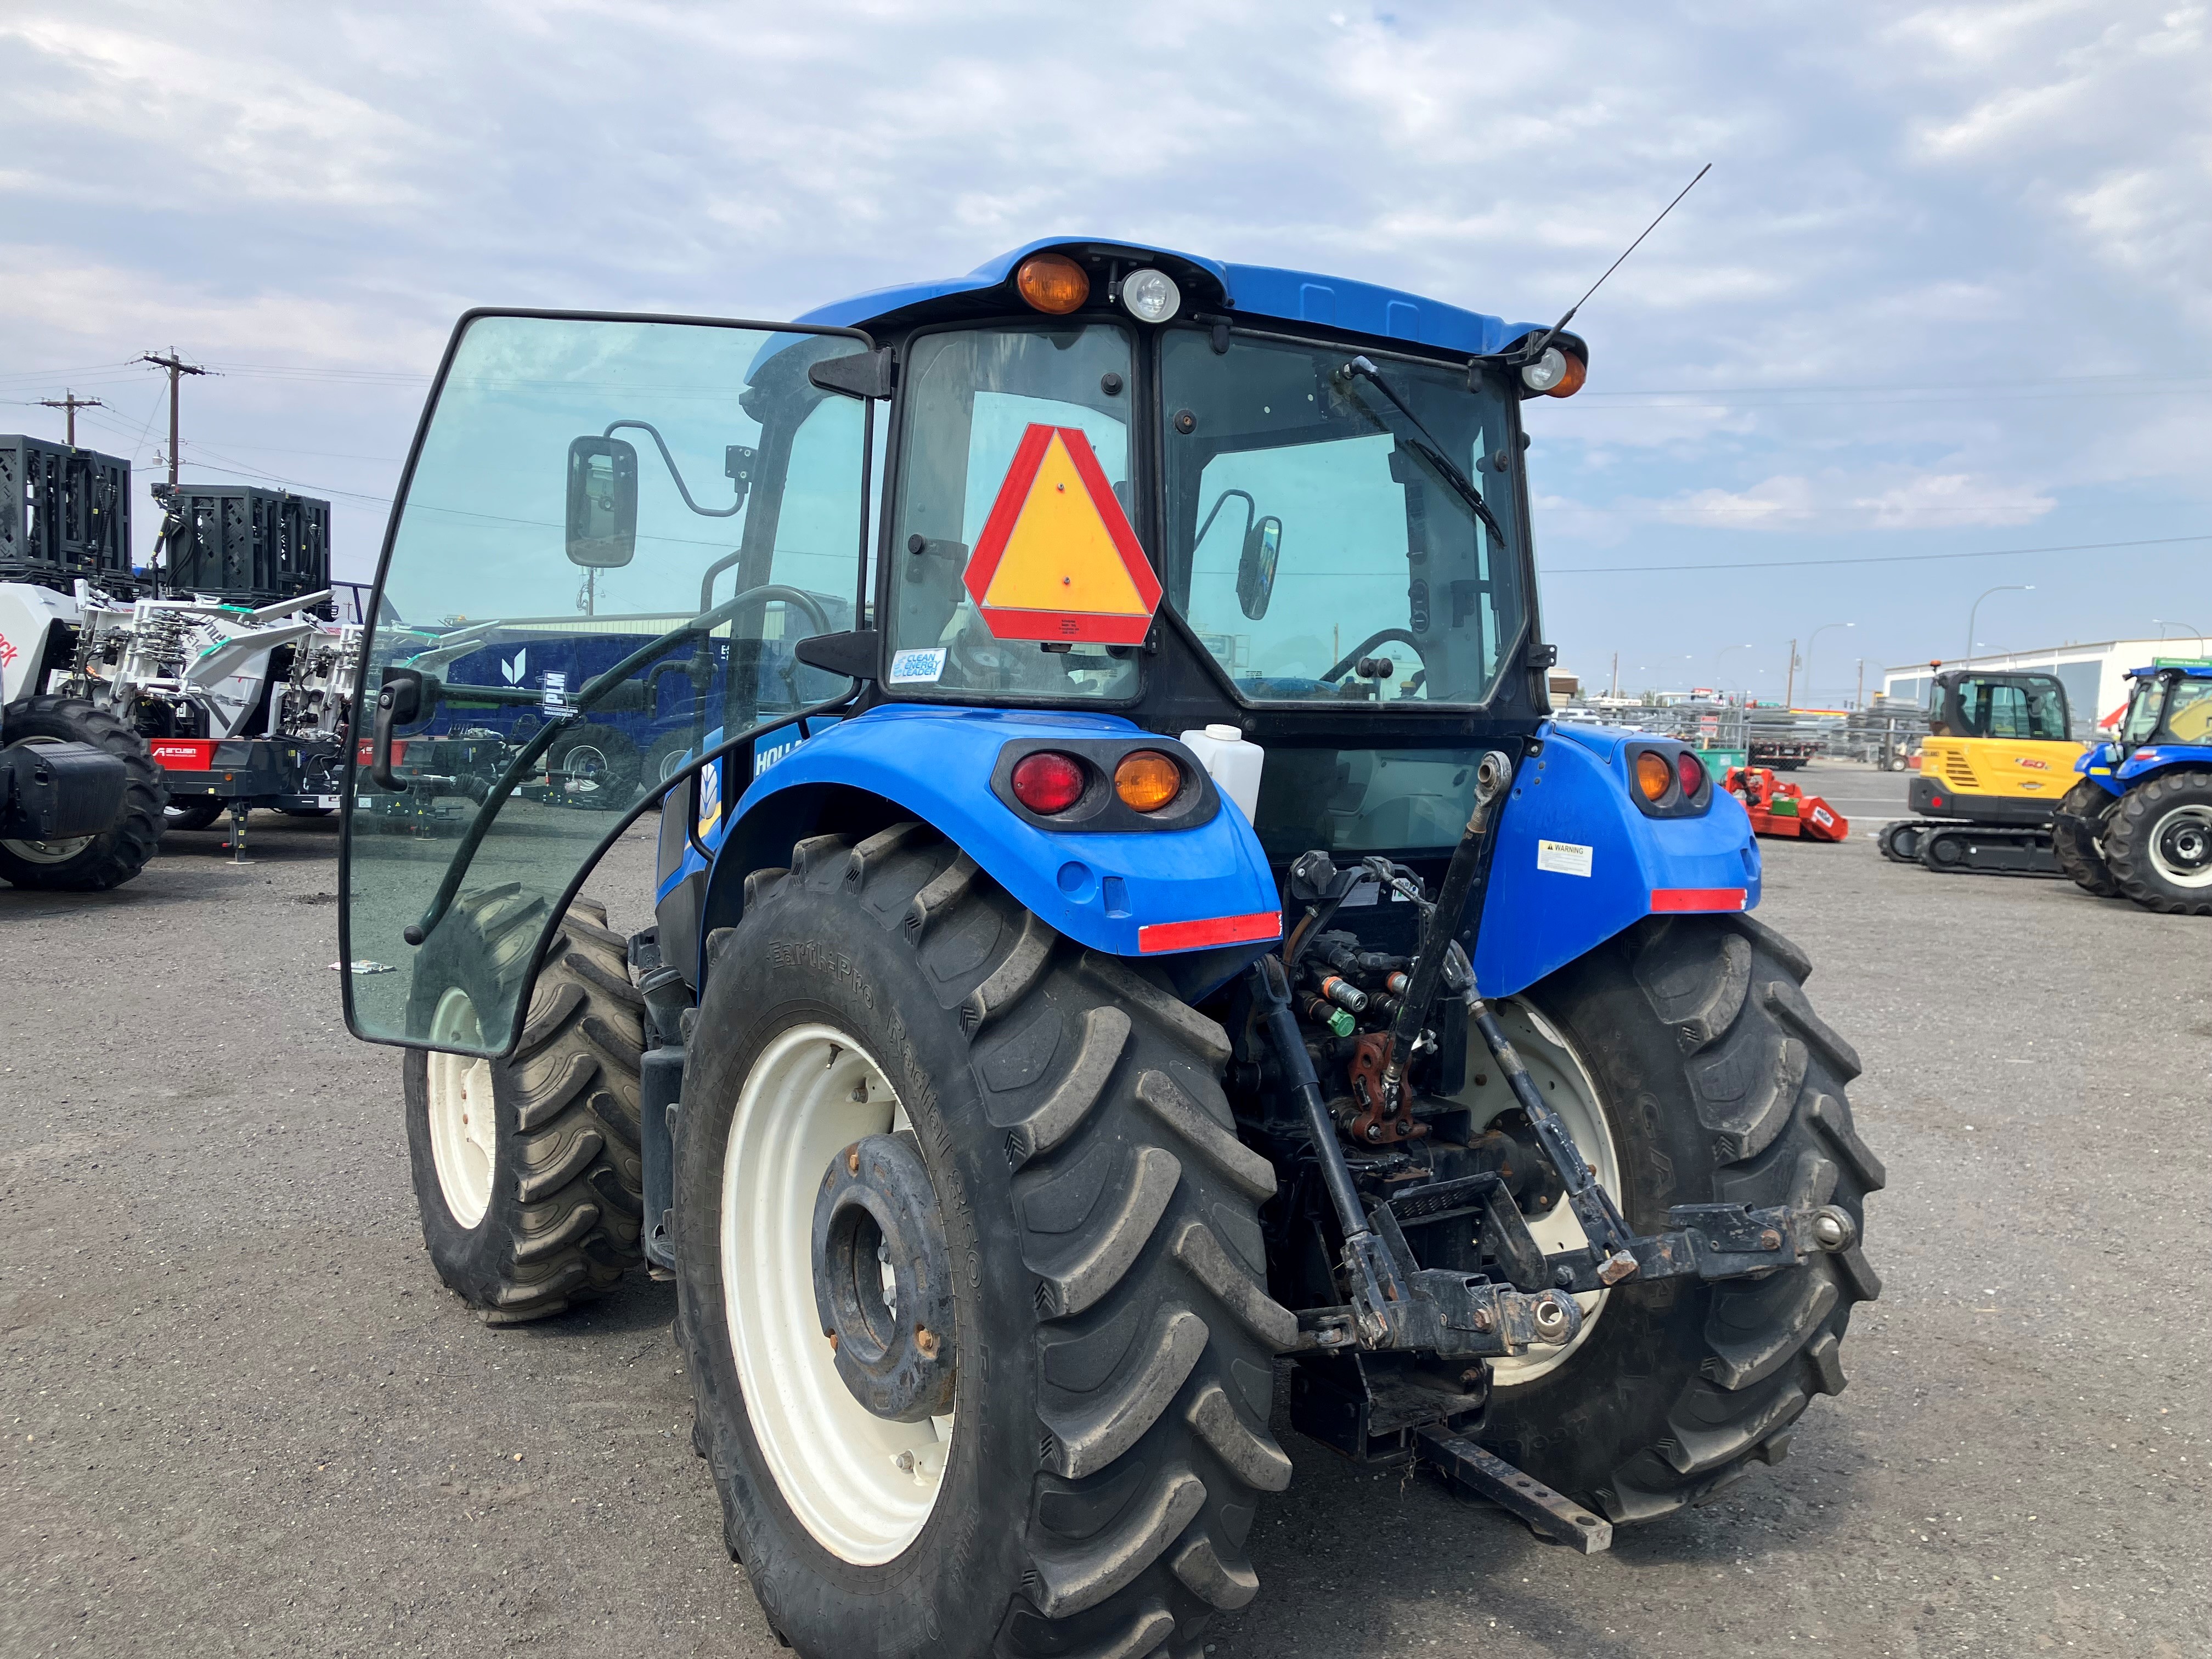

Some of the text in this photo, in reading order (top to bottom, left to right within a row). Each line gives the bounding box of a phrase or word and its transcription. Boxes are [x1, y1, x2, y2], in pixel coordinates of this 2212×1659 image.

[907, 653, 936, 662] CLEAN
[904, 661, 941, 669] ENERGY
[545, 673, 565, 704] PLM
[1555, 844, 1584, 854] WARNING
[769, 939, 874, 1009] Earth-Pro
[947, 1169, 983, 1288] 850
